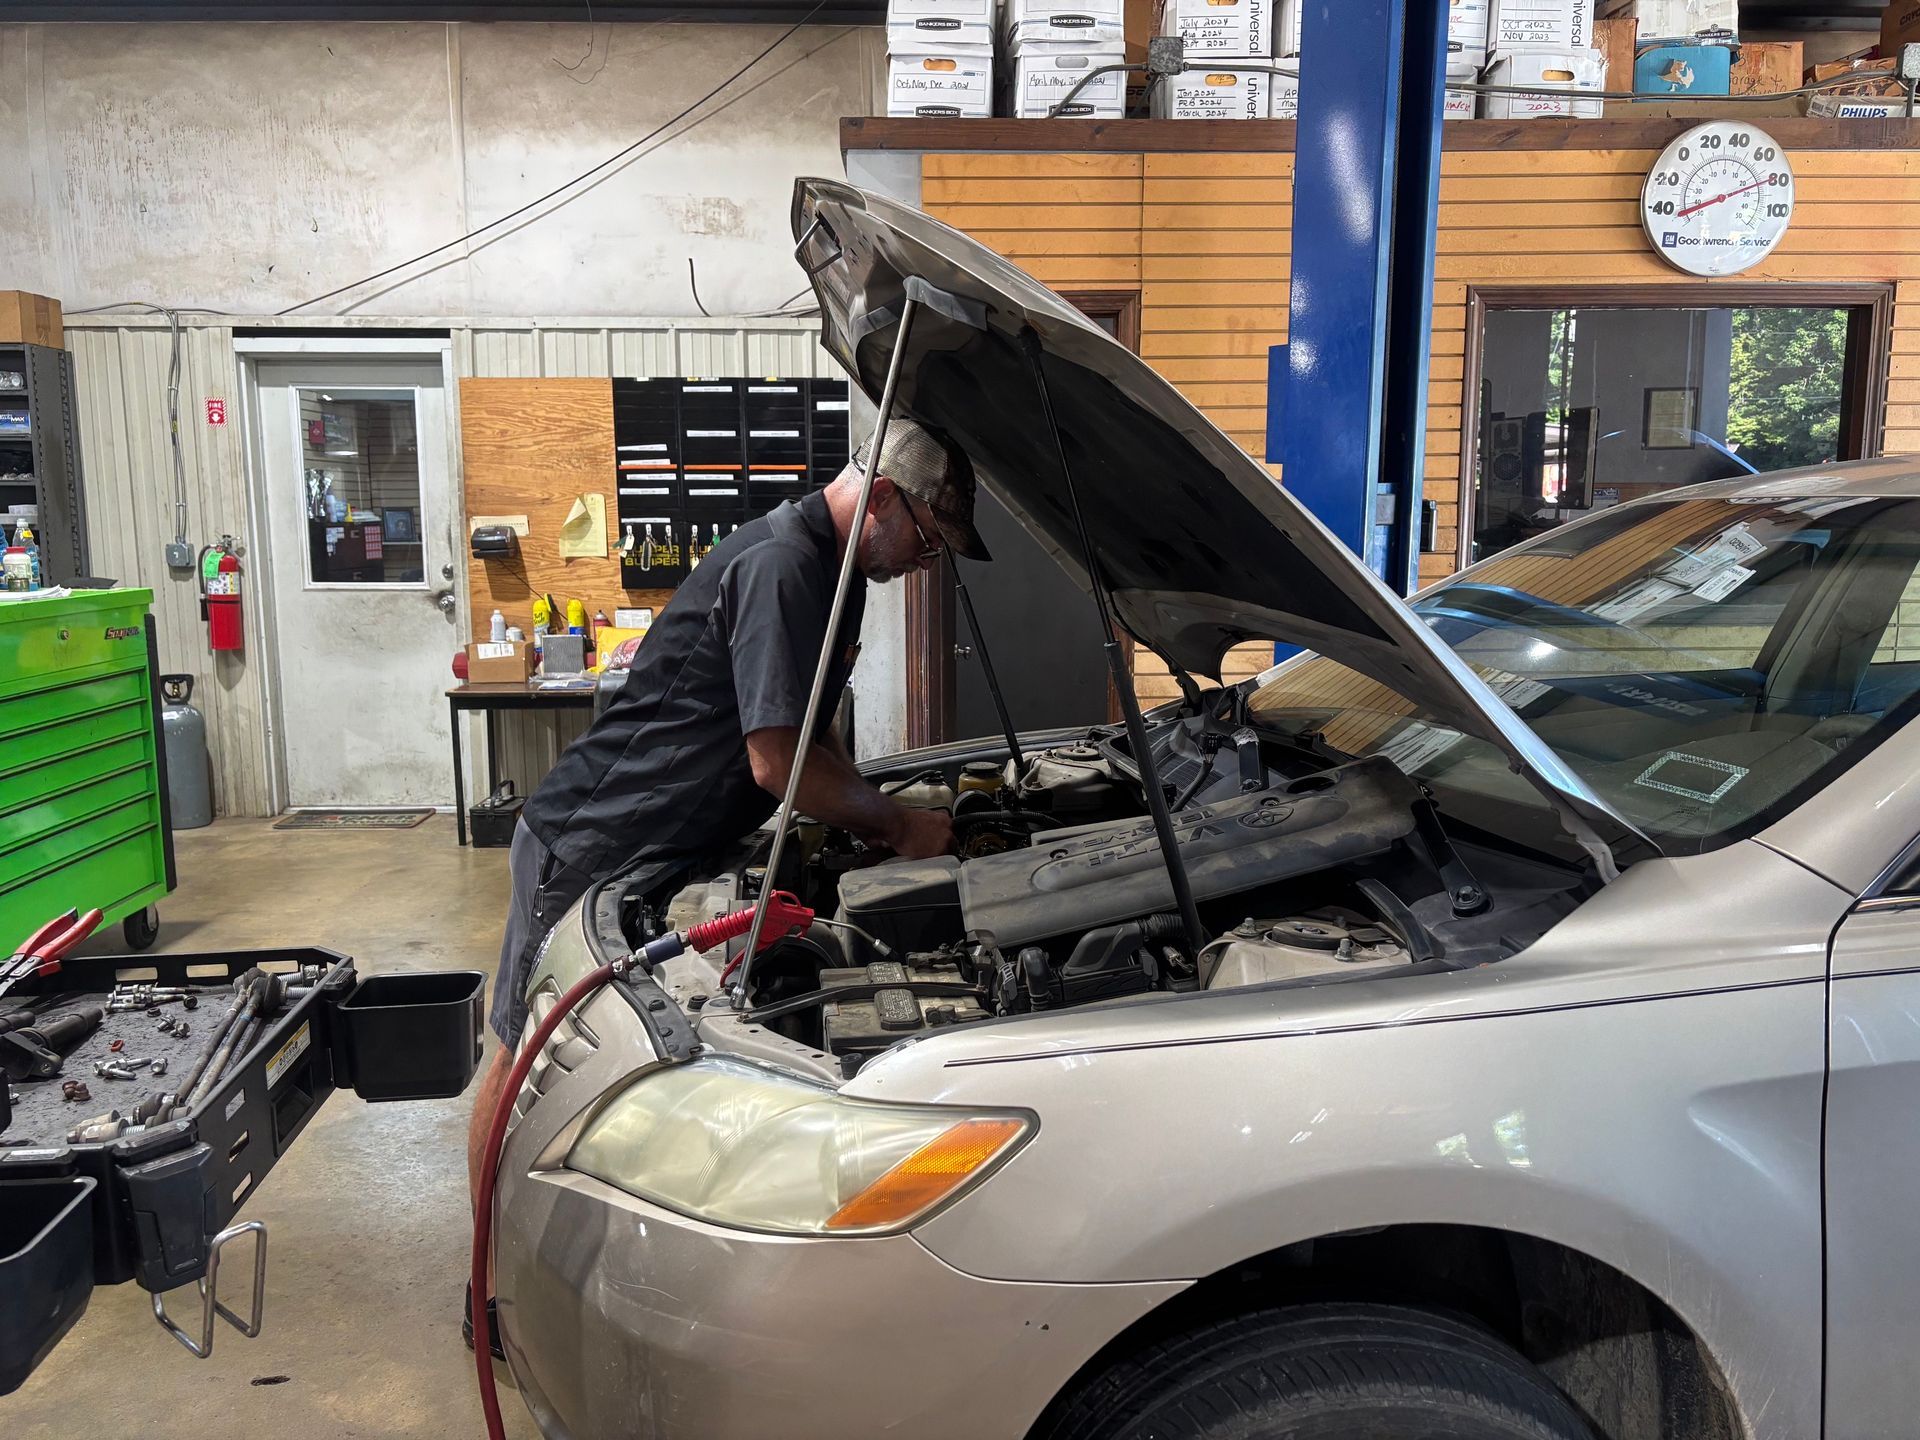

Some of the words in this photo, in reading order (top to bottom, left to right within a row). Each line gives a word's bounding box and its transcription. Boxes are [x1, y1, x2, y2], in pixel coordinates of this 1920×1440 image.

[1180, 18, 1198, 30] July
[1249, 0, 1262, 54] niversal
[1571, 0, 1585, 47] niversal
[1526, 102, 1561, 112] 2023
[1841, 108, 1888, 117] PHILIPS
[1700, 135, 1721, 149] 20
[1729, 133, 1750, 147] 40
[1678, 147, 1690, 161] 0
[1754, 147, 1775, 162] 60
[1655, 172, 1679, 186] -20
[1768, 173, 1789, 187] 80
[1648, 201, 1674, 215] -40
[1767, 203, 1789, 217] 100
[1678, 236, 1738, 246] Goowrenc
[625, 558, 680, 566] BUPER
